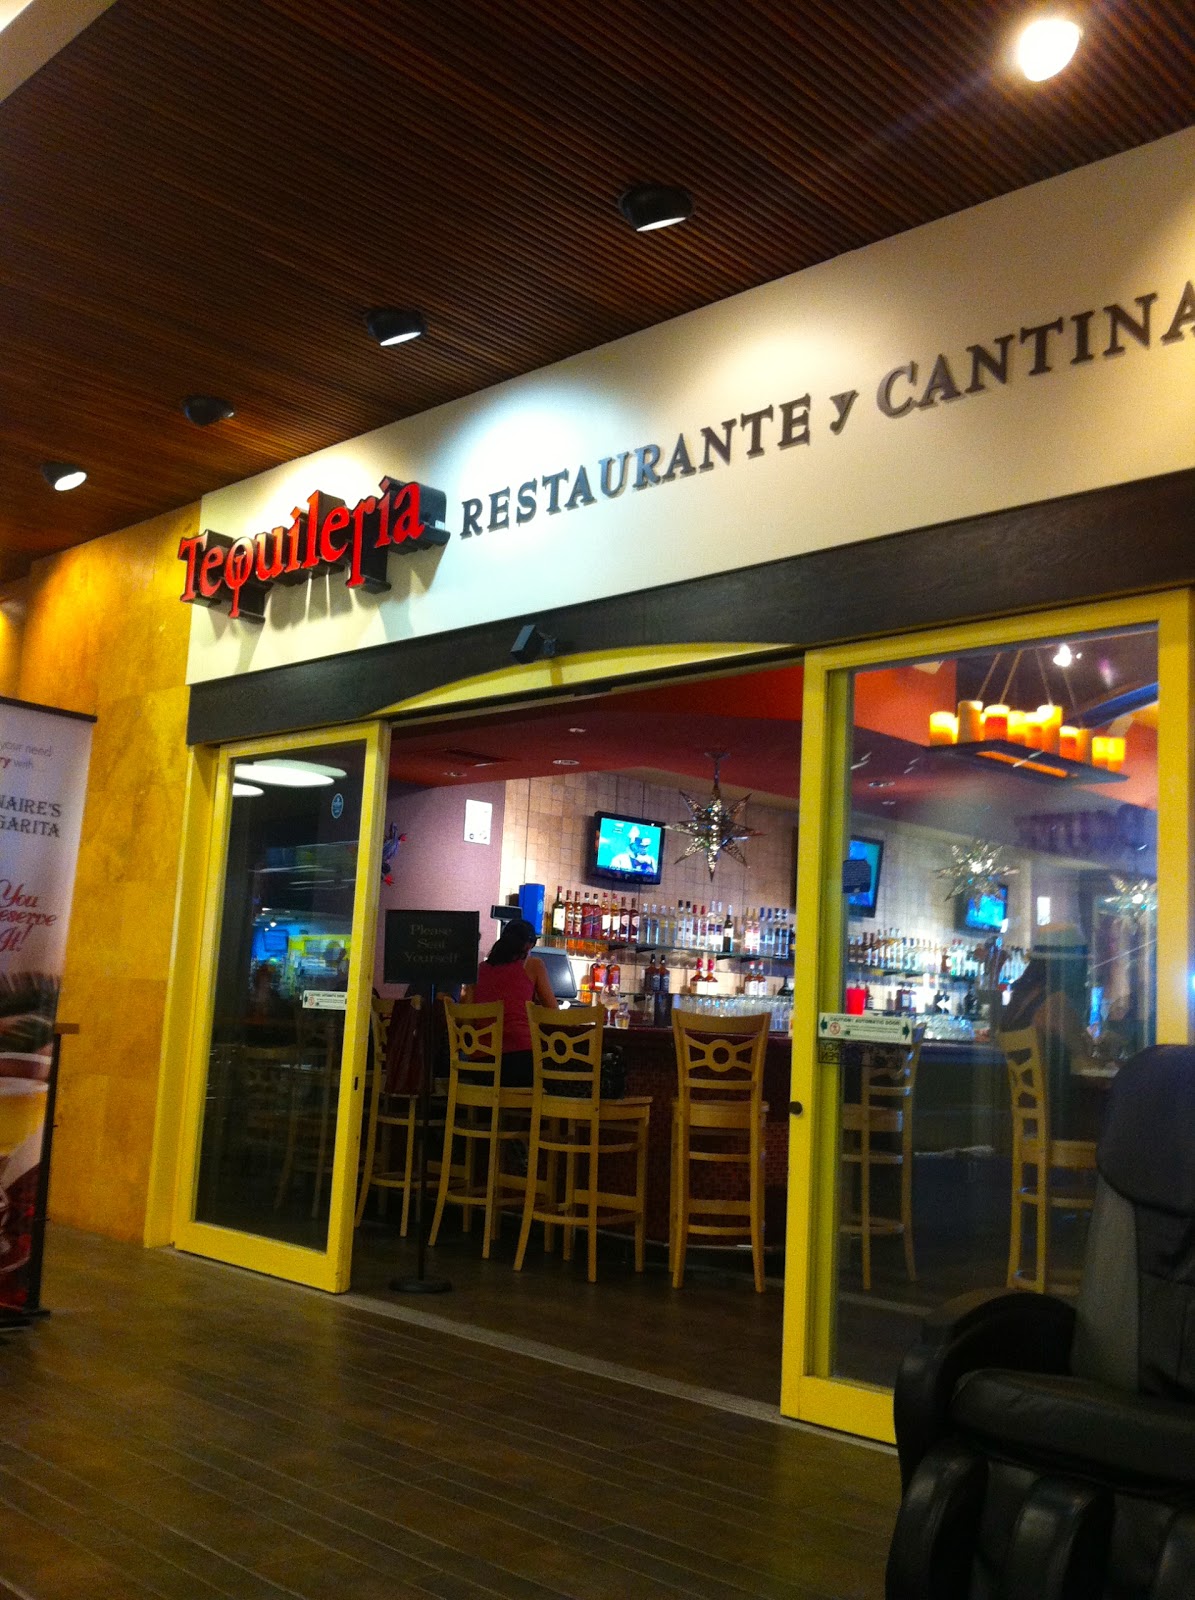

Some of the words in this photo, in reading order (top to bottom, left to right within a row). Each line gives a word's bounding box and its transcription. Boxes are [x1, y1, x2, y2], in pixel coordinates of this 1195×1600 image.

[460, 393, 811, 540] RESTAURANTE
[876, 280, 1195, 419] CANTINA
[0, 879, 39, 908] You
[409, 923, 453, 936] Please
[417, 938, 446, 949] Seat
[404, 951, 458, 964] Yourself
